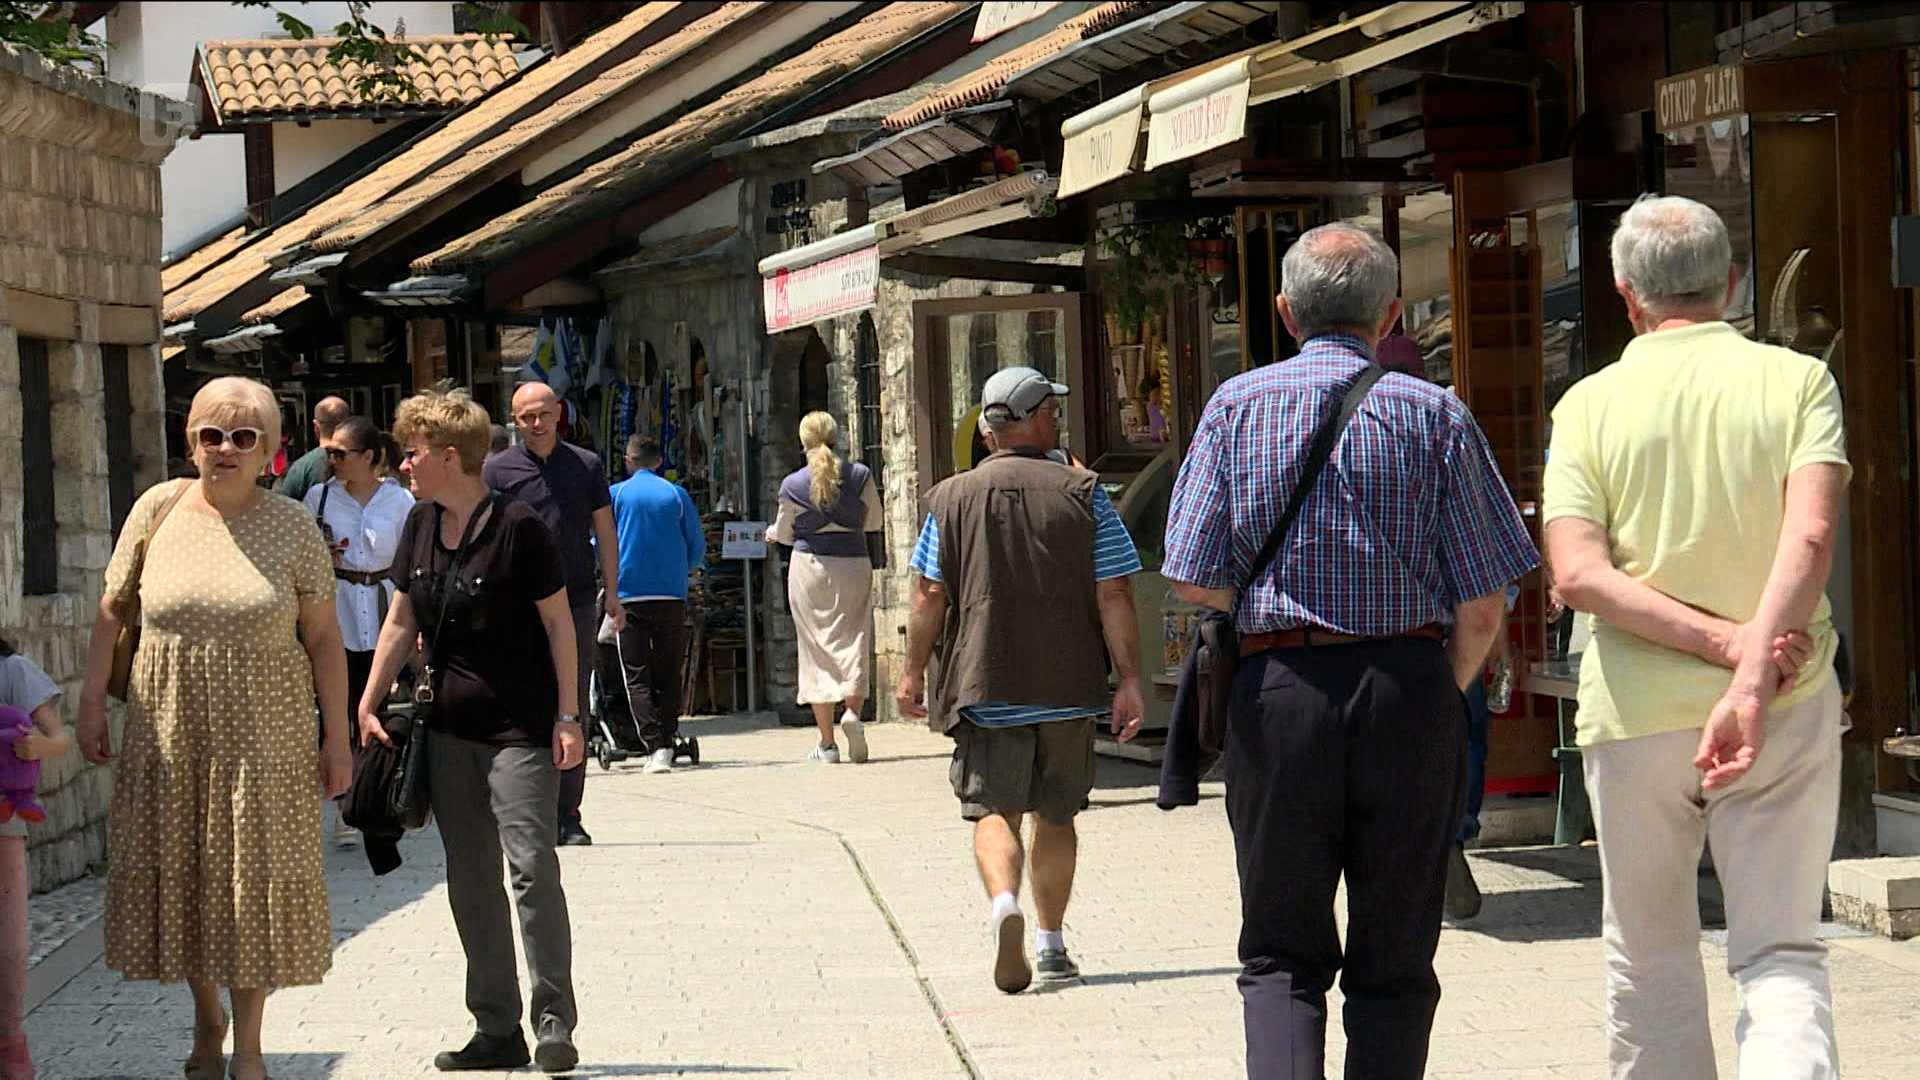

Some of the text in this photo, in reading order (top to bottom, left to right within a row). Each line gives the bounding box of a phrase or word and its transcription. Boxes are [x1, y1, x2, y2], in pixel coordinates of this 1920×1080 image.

[1660, 66, 1740, 127] OTKUP ZLATA
[1089, 129, 1113, 176] PINTO
